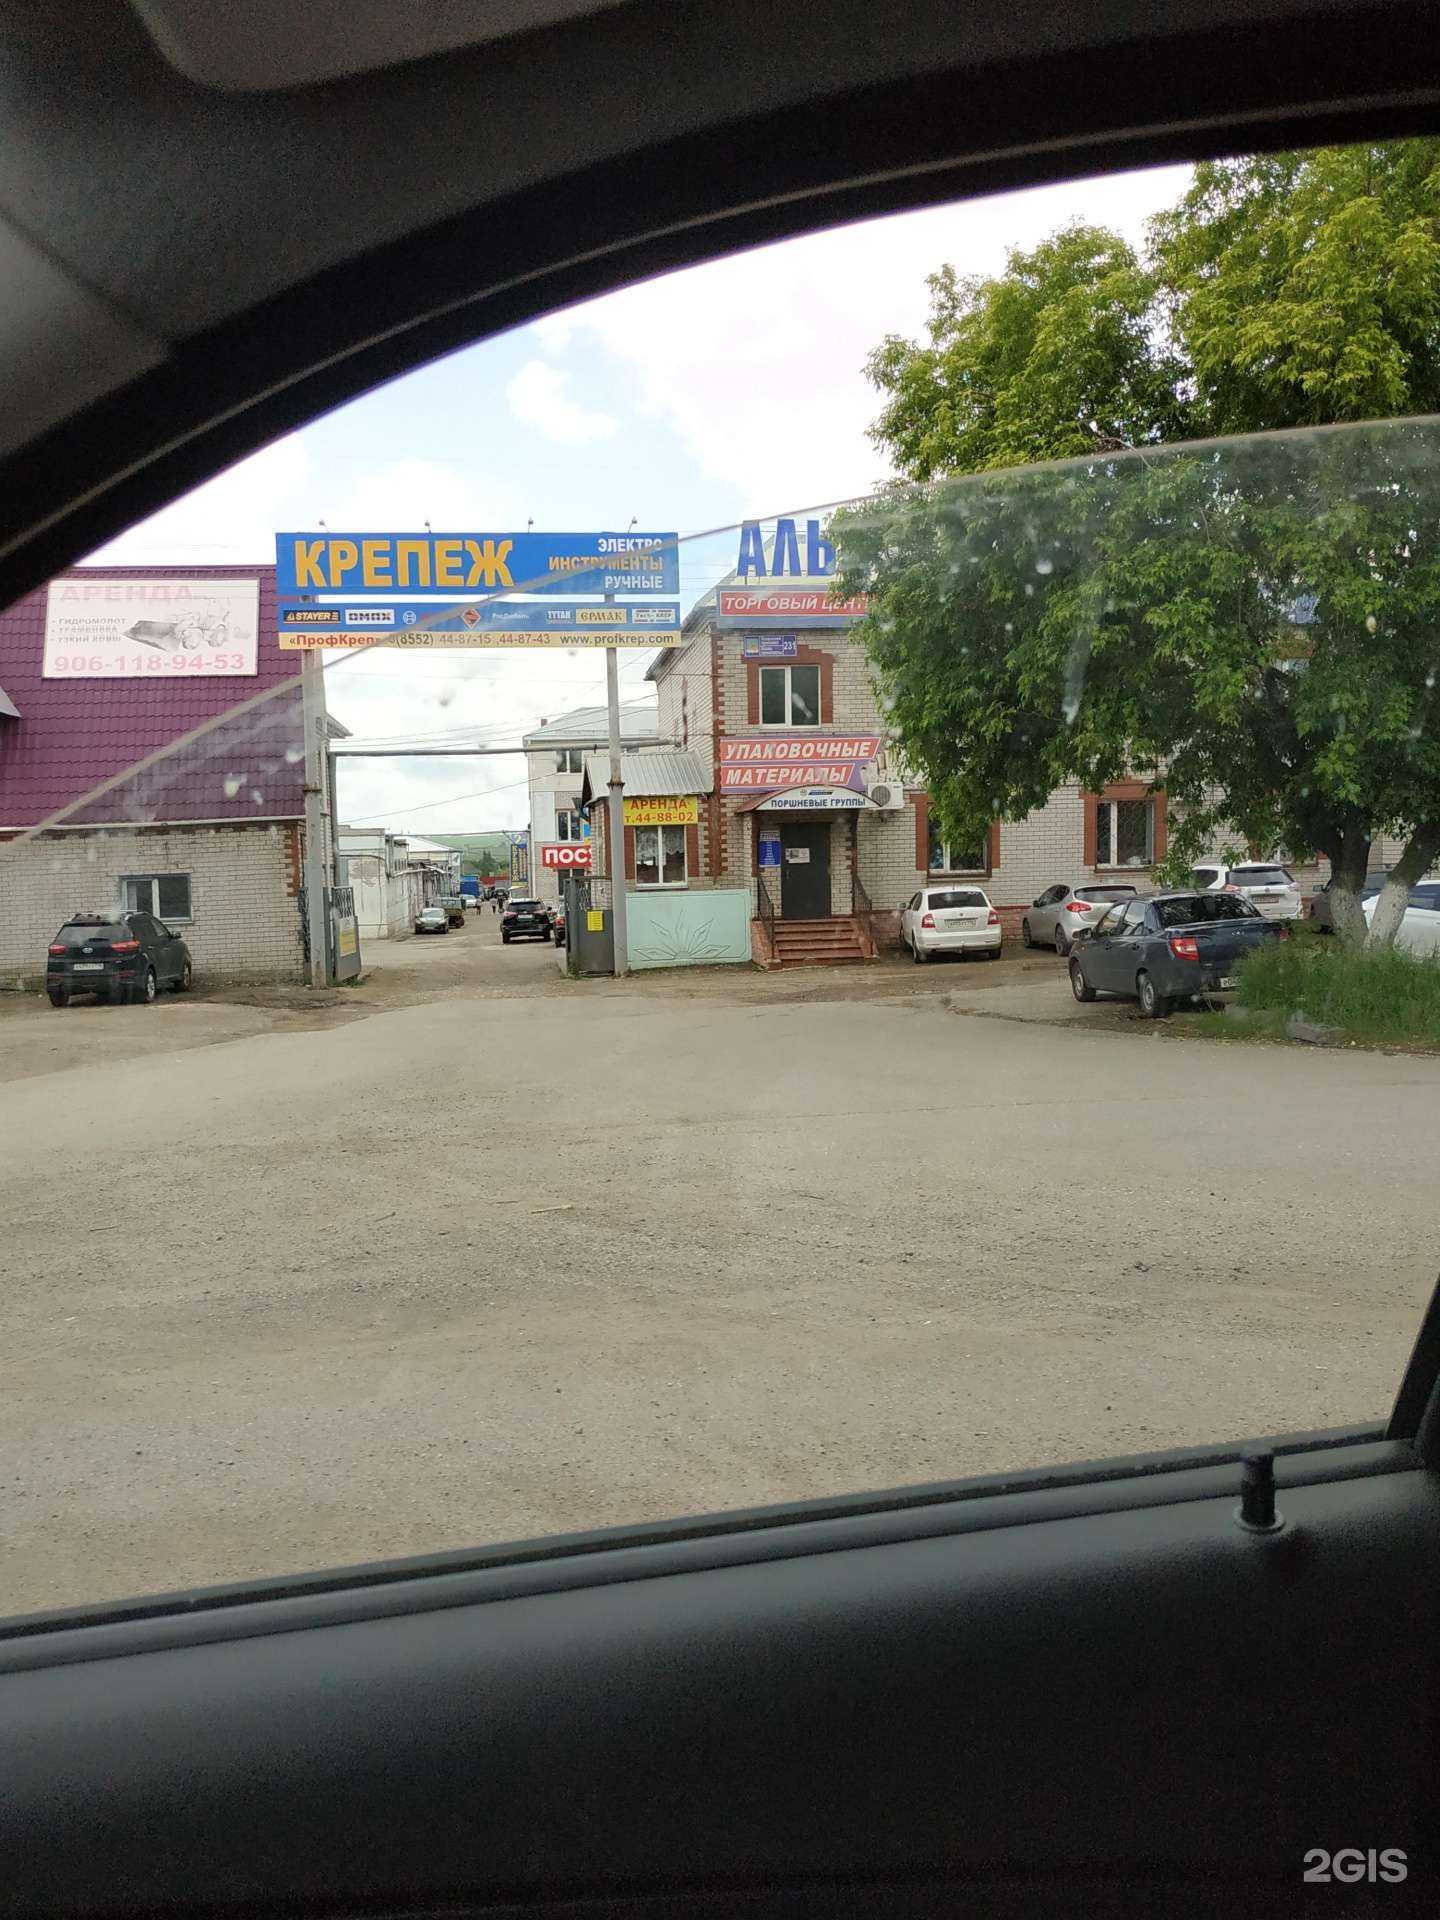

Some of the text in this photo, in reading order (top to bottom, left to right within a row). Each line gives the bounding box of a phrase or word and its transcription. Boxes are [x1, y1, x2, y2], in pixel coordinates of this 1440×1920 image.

[598, 539, 662, 552] ЭЛЕКТРО
[294, 540, 514, 587] КРЕПЕЖ
[549, 556, 663, 570] ИНСТРУМЕНТЫ
[605, 576, 663, 588] РУЧНЫЕ
[60, 586, 193, 605] АРЕНДА
[725, 595, 818, 610] ТОРГОВЫЙ
[296, 612, 331, 621] STAYER
[560, 633, 674, 646] www.profkrep.com
[54, 654, 246, 671] 906-118-94-53
[726, 742, 872, 759] УПАКОВОЧНЫЕ
[726, 767, 848, 784] МАТЕРИАЛЫ
[630, 799, 688, 811] АРЕНДА
[771, 798, 866, 807] ПОРШНЕВЫЕ ГРУППЫ
[545, 849, 592, 863] ПОС
